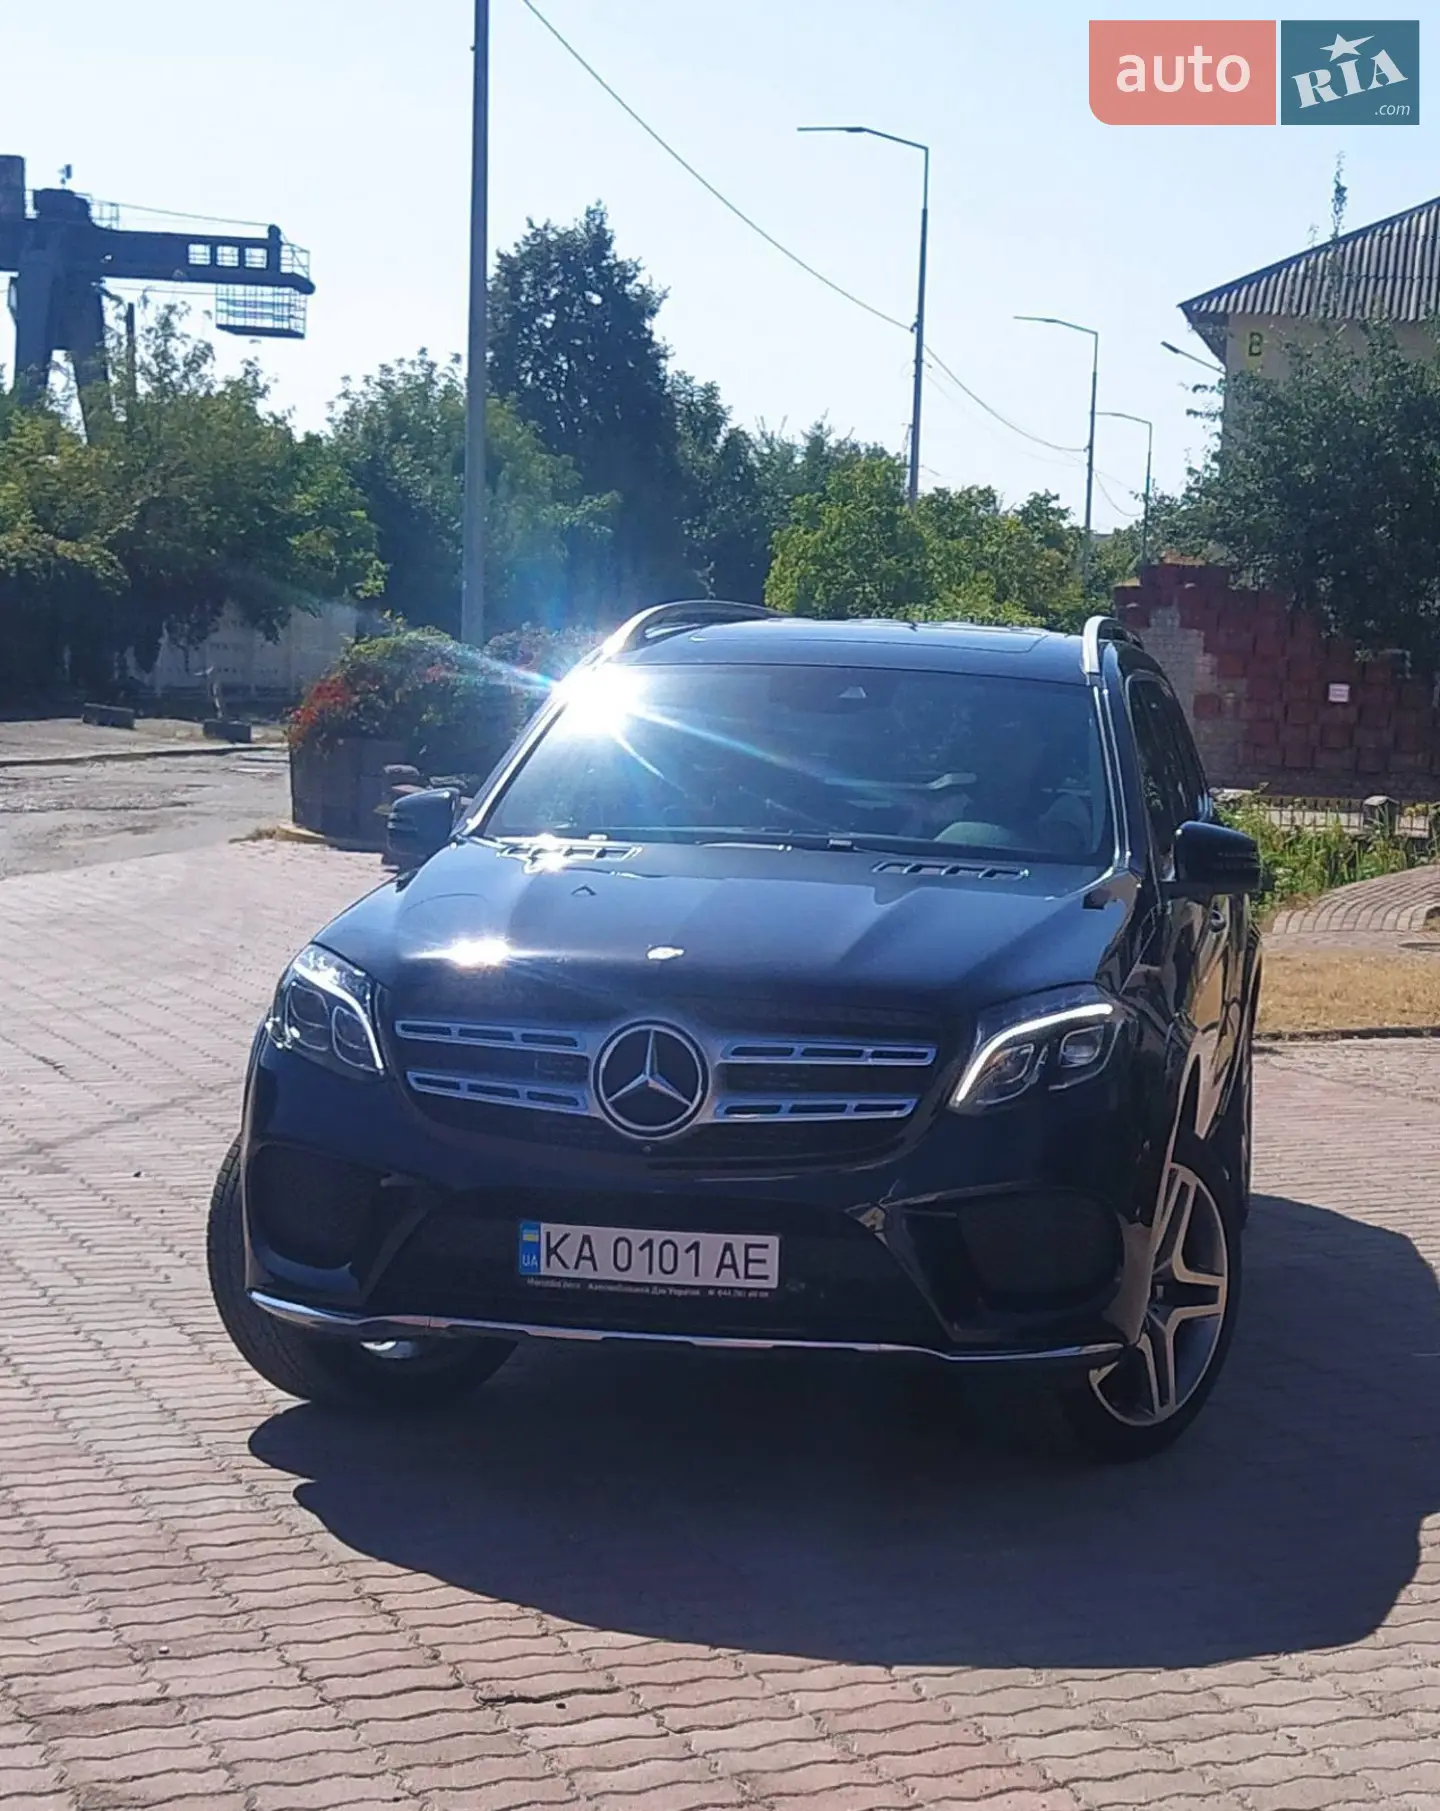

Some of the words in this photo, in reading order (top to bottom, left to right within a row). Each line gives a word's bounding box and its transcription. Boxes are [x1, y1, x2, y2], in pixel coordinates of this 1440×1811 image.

[522, 1253, 539, 1268] UA
[545, 1231, 598, 1272] KA
[613, 1236, 701, 1277] 0101
[715, 1242, 770, 1281] AE
